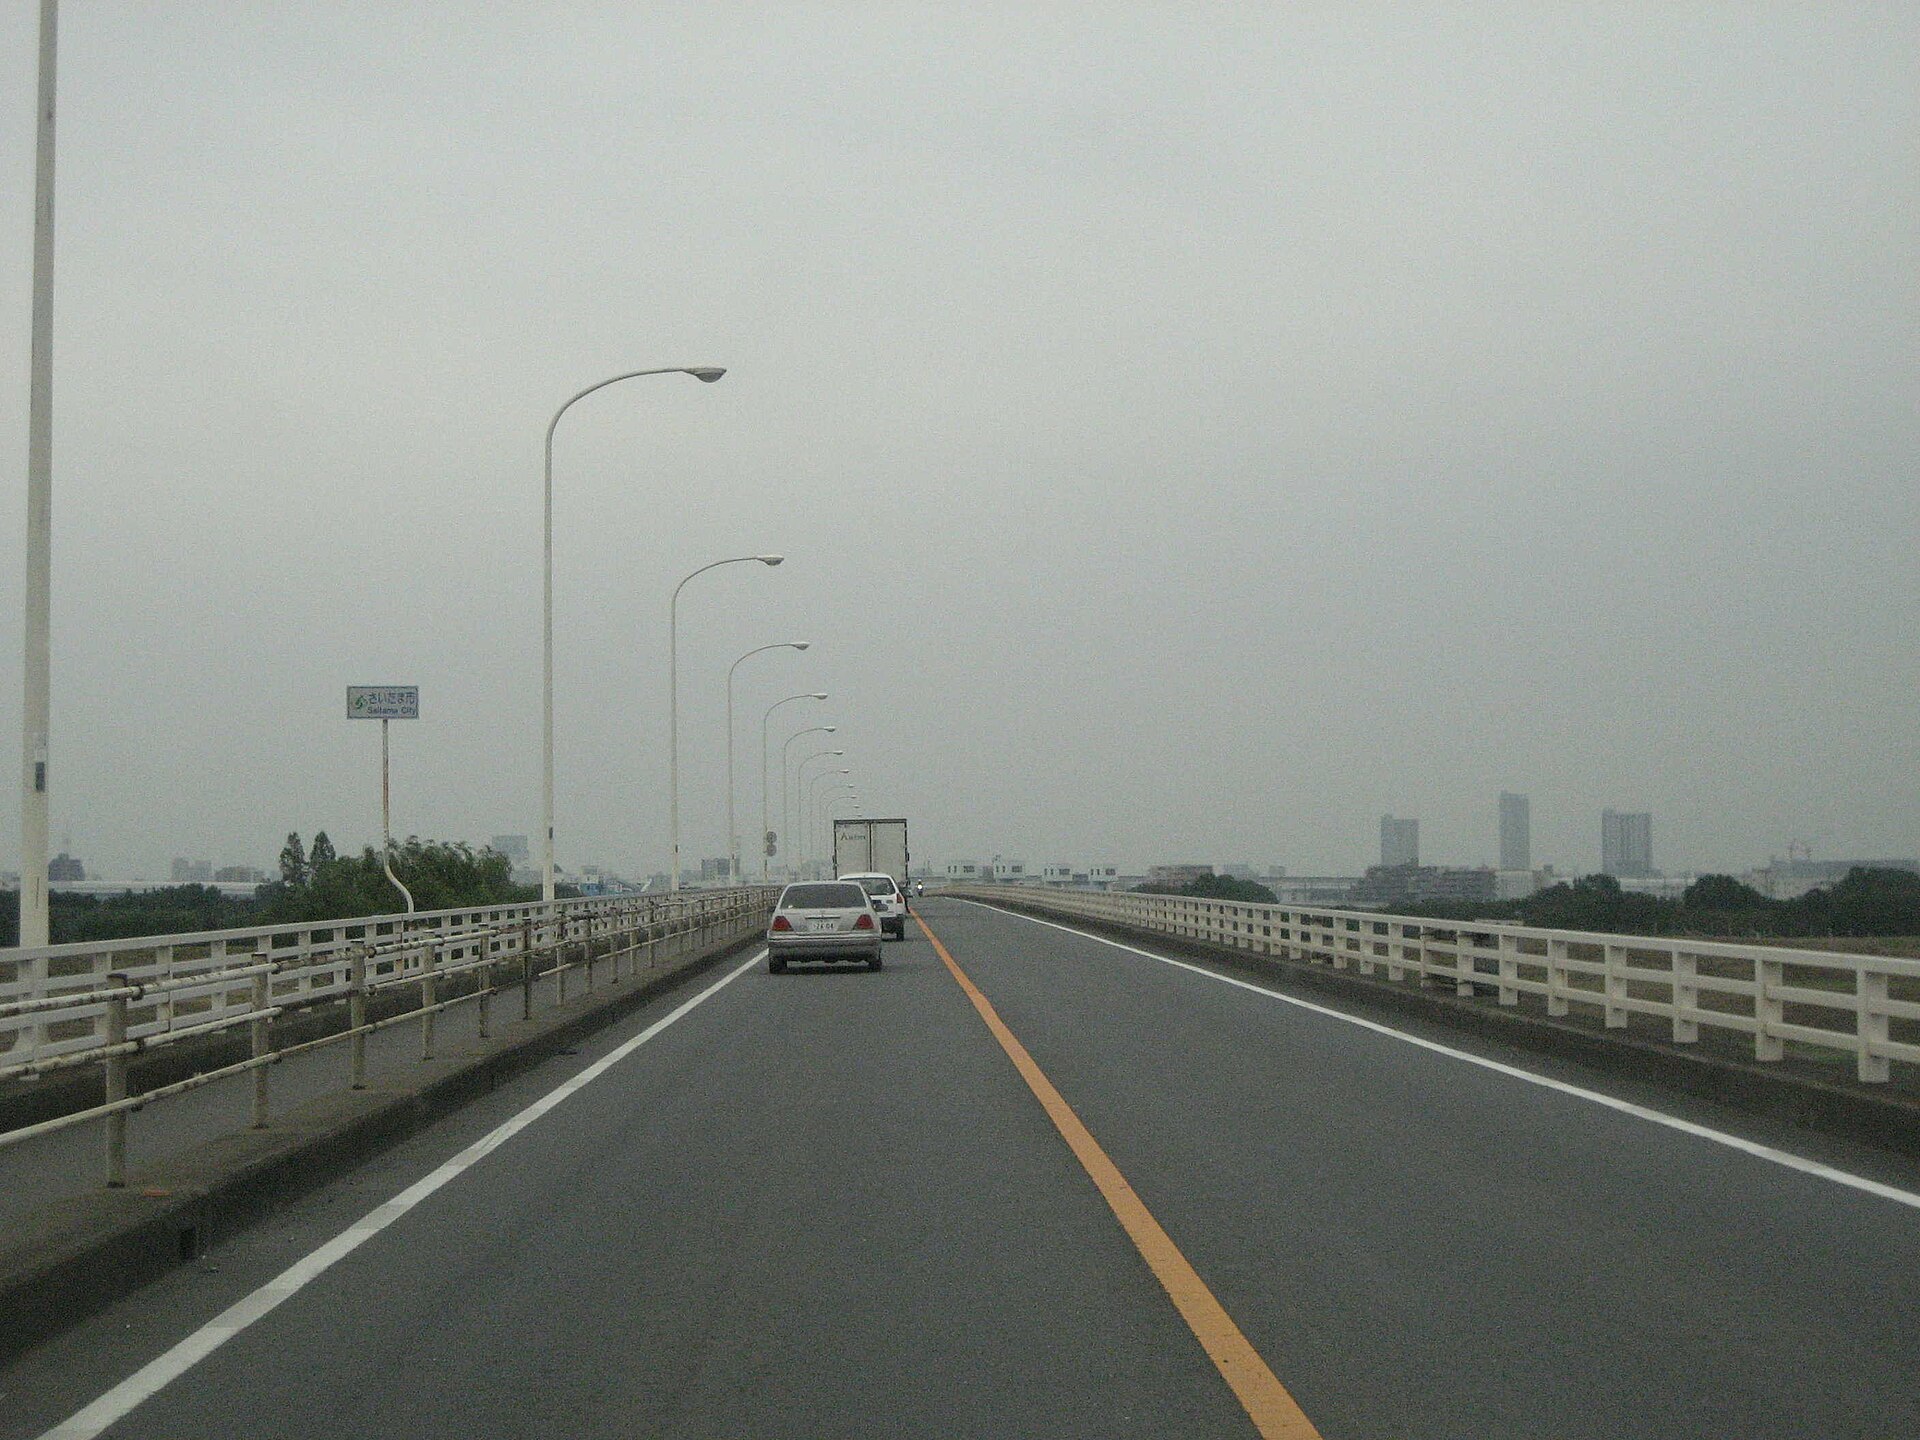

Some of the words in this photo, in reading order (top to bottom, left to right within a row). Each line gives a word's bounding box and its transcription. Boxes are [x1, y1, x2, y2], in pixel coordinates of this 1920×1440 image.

[369, 691, 415, 704] さいたま市
[367, 705, 399, 714] Saitama
[401, 705, 416, 715] City
